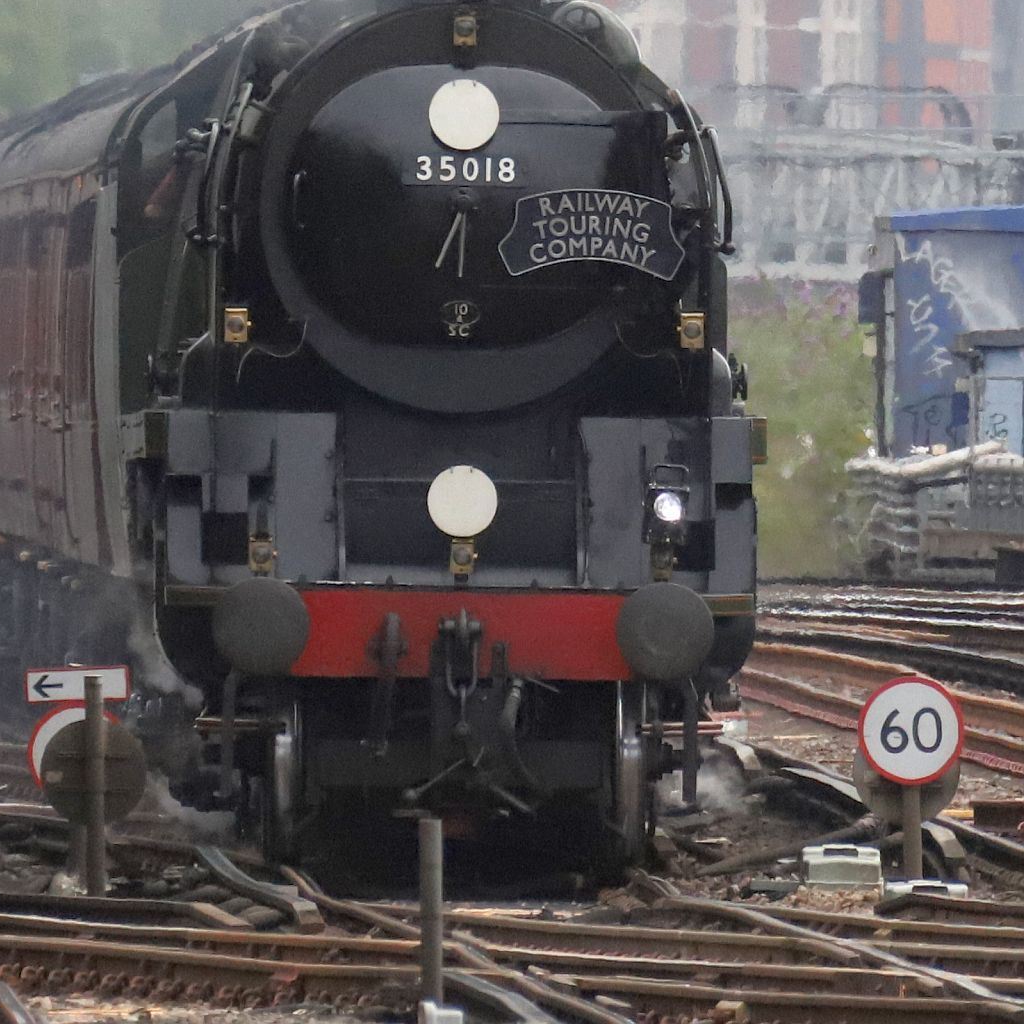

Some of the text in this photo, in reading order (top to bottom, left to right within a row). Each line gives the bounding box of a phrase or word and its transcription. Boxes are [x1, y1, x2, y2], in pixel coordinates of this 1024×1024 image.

[416, 156, 515, 182] 35018
[538, 193, 650, 218] RAILWAY
[533, 216, 651, 243] TOURING
[529, 237, 657, 267] COMPANY
[880, 707, 943, 754] 60
